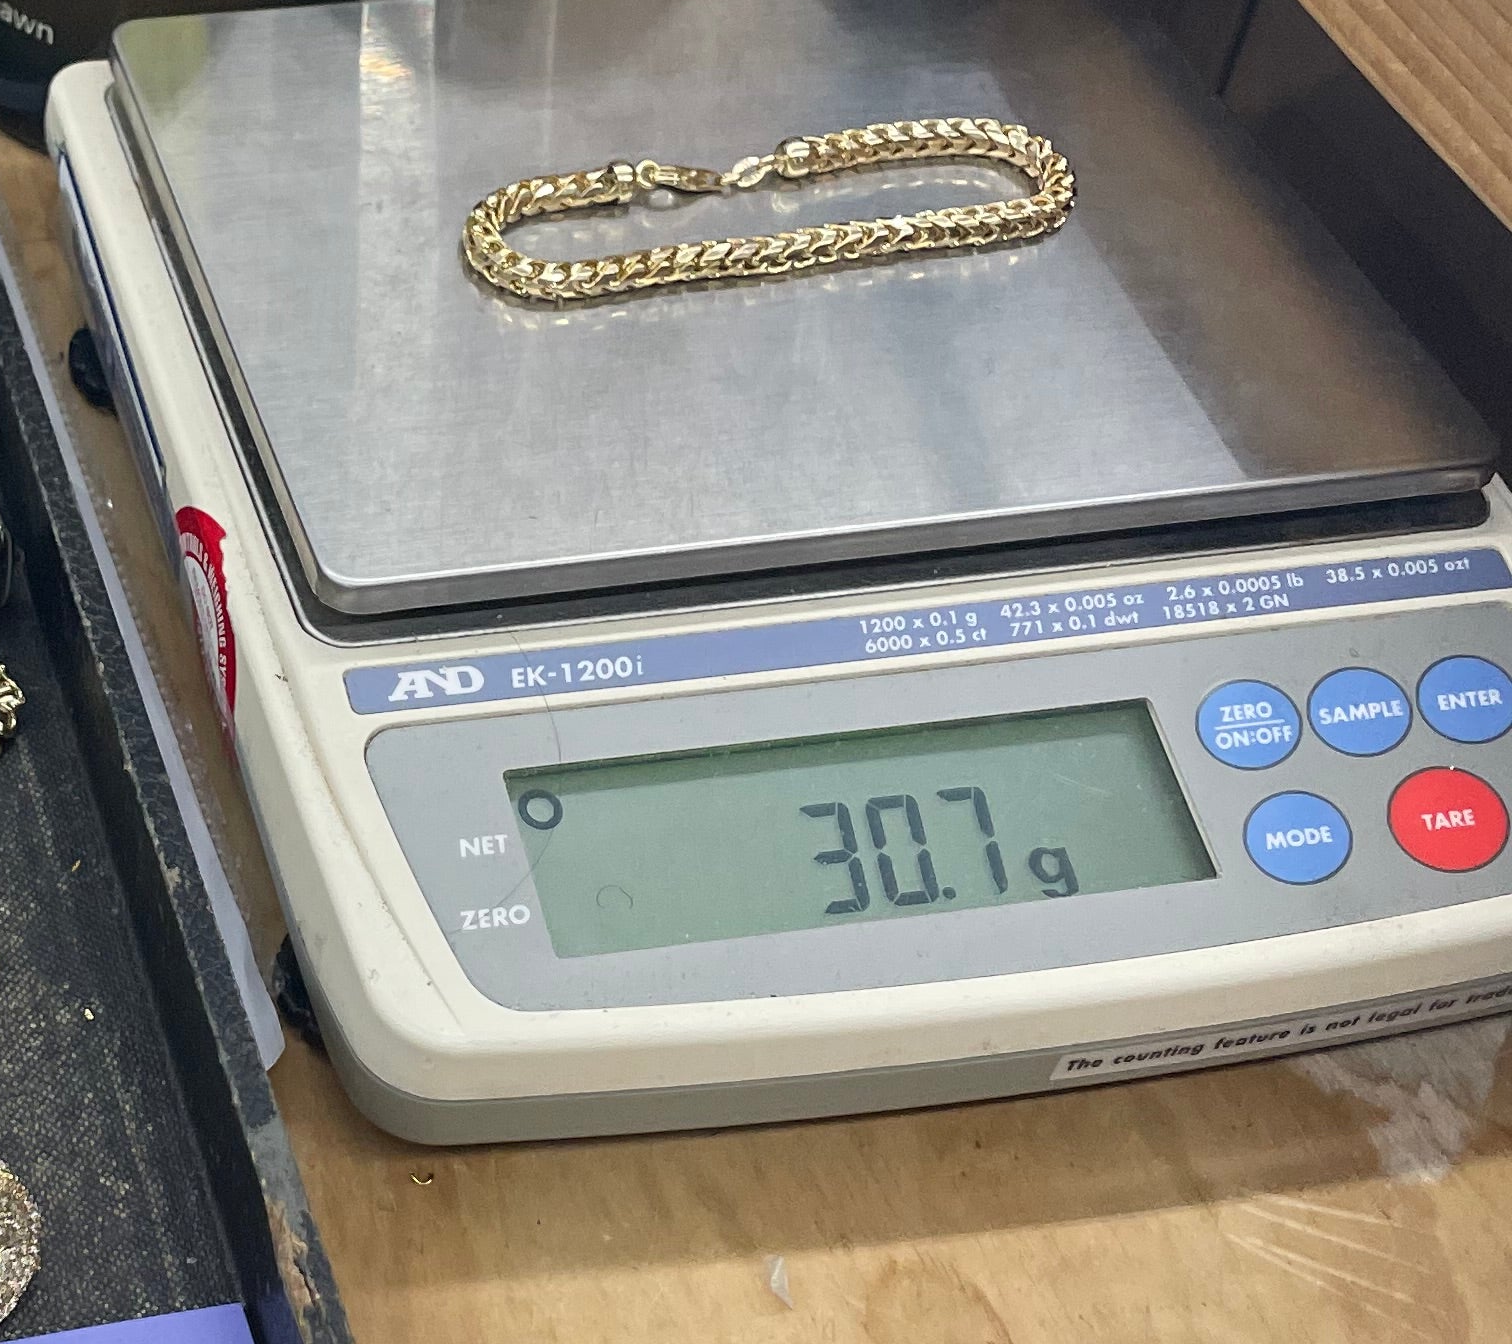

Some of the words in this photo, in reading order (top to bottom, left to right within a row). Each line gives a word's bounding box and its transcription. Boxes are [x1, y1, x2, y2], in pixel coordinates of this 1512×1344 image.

[860, 615, 906, 634] 1200
[913, 617, 924, 629] x
[929, 610, 958, 627] 0.1
[965, 611, 978, 627] g
[1000, 600, 1041, 618] 42.3
[1048, 602, 1060, 614] x
[1064, 592, 1117, 612] 0.005
[1123, 593, 1144, 606] oz
[1166, 585, 1196, 602] 2.6
[1201, 586, 1213, 598] x
[1218, 575, 1281, 596] 0.0005
[1286, 572, 1304, 588] lb
[1326, 567, 1366, 585] 38.5
[1372, 568, 1383, 580] x
[1387, 558, 1438, 577] 0.005
[1444, 557, 1470, 571] ozt
[864, 635, 913, 654] 6000
[919, 636, 931, 648] x
[936, 628, 966, 646] 0.5
[972, 627, 987, 641] ct
[1009, 619, 1044, 638] 771
[1052, 622, 1063, 633] x
[1069, 613, 1097, 631] 0.1
[1104, 610, 1140, 627] dwt
[1163, 601, 1220, 621] 18518
[1226, 603, 1237, 614] x
[1245, 596, 1256, 612] 2
[1259, 594, 1290, 611] GN
[511, 654, 644, 689] EK-1200i
[1220, 701, 1273, 723] ZERO
[1318, 699, 1404, 725] SAMPLE
[1437, 688, 1503, 712] ENTER
[1420, 808, 1476, 831] TARE
[459, 834, 508, 858] NET
[799, 786, 1009, 914] 30.7
[1028, 846, 1079, 899] g
[1265, 825, 1334, 851] MODE
[460, 904, 530, 931] ZERO
[1067, 1058, 1103, 1072] The
[1113, 1041, 1205, 1066] counting
[1214, 1027, 1291, 1050] feature
[1299, 1022, 1317, 1036] is
[1324, 1014, 1361, 1030] not
[1367, 1002, 1422, 1025] legal
[1428, 995, 1463, 1011] for
